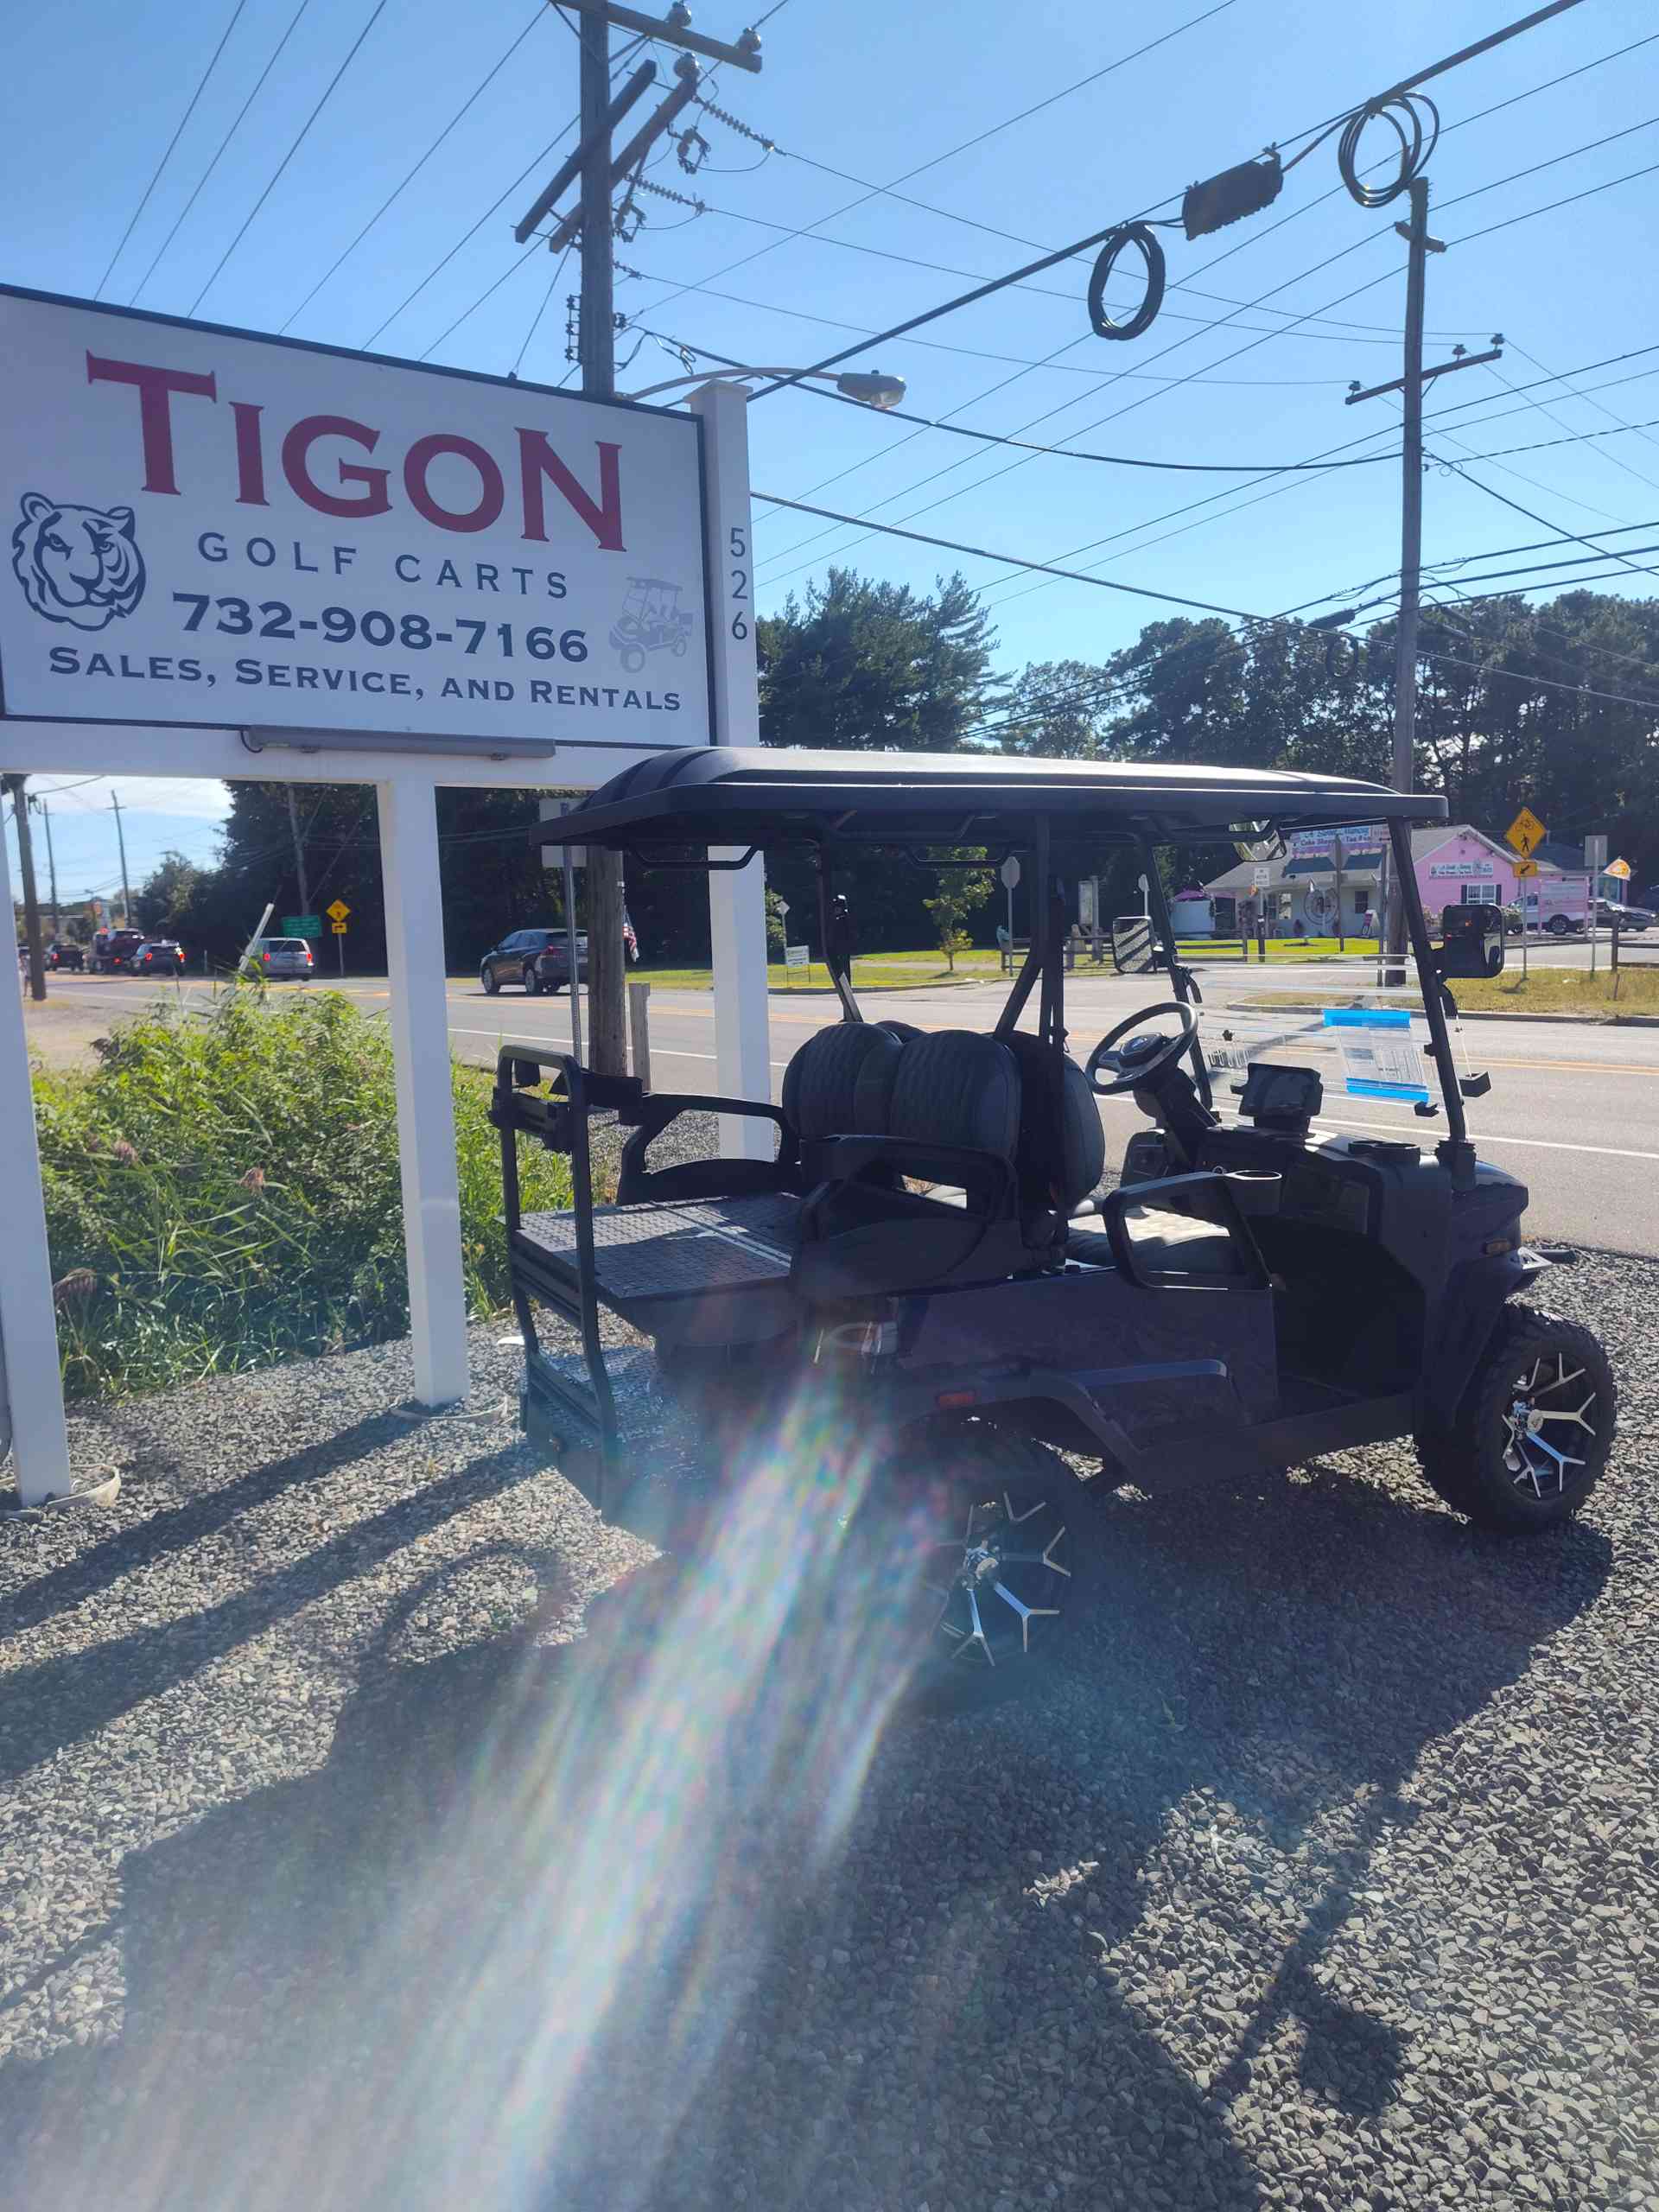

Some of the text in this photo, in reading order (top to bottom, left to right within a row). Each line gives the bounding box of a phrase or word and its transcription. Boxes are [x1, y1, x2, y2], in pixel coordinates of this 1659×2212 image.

[86, 349, 627, 553] TIGON
[198, 531, 568, 600] GOLF CARTS
[172, 591, 588, 664] 732-908-7166
[48, 646, 681, 711] SALES, SERVICE, AND RENTALS
